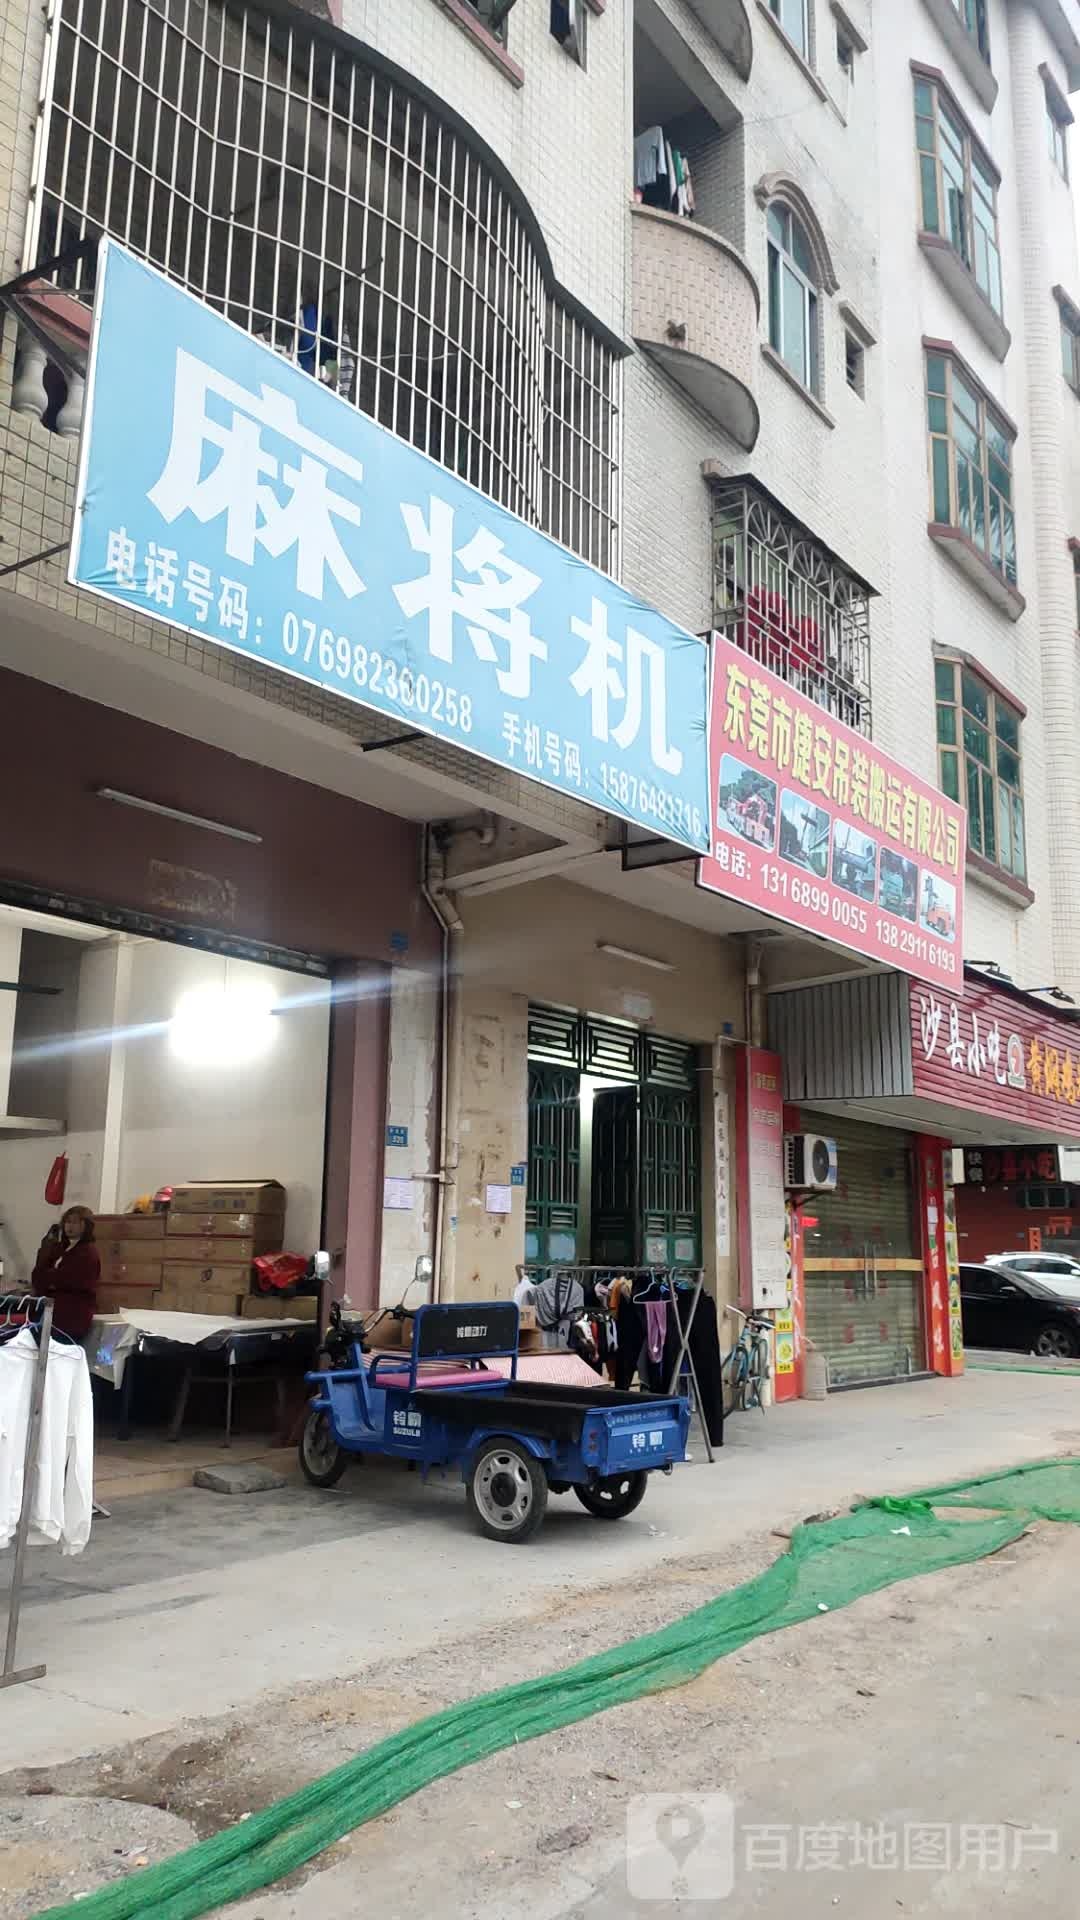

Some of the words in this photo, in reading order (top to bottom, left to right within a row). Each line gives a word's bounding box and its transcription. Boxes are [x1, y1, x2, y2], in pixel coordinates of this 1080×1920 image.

[146, 346, 683, 776] 麻将机
[283, 616, 473, 734] 076982360258
[919, 993, 1007, 1085] 沙县小吃
